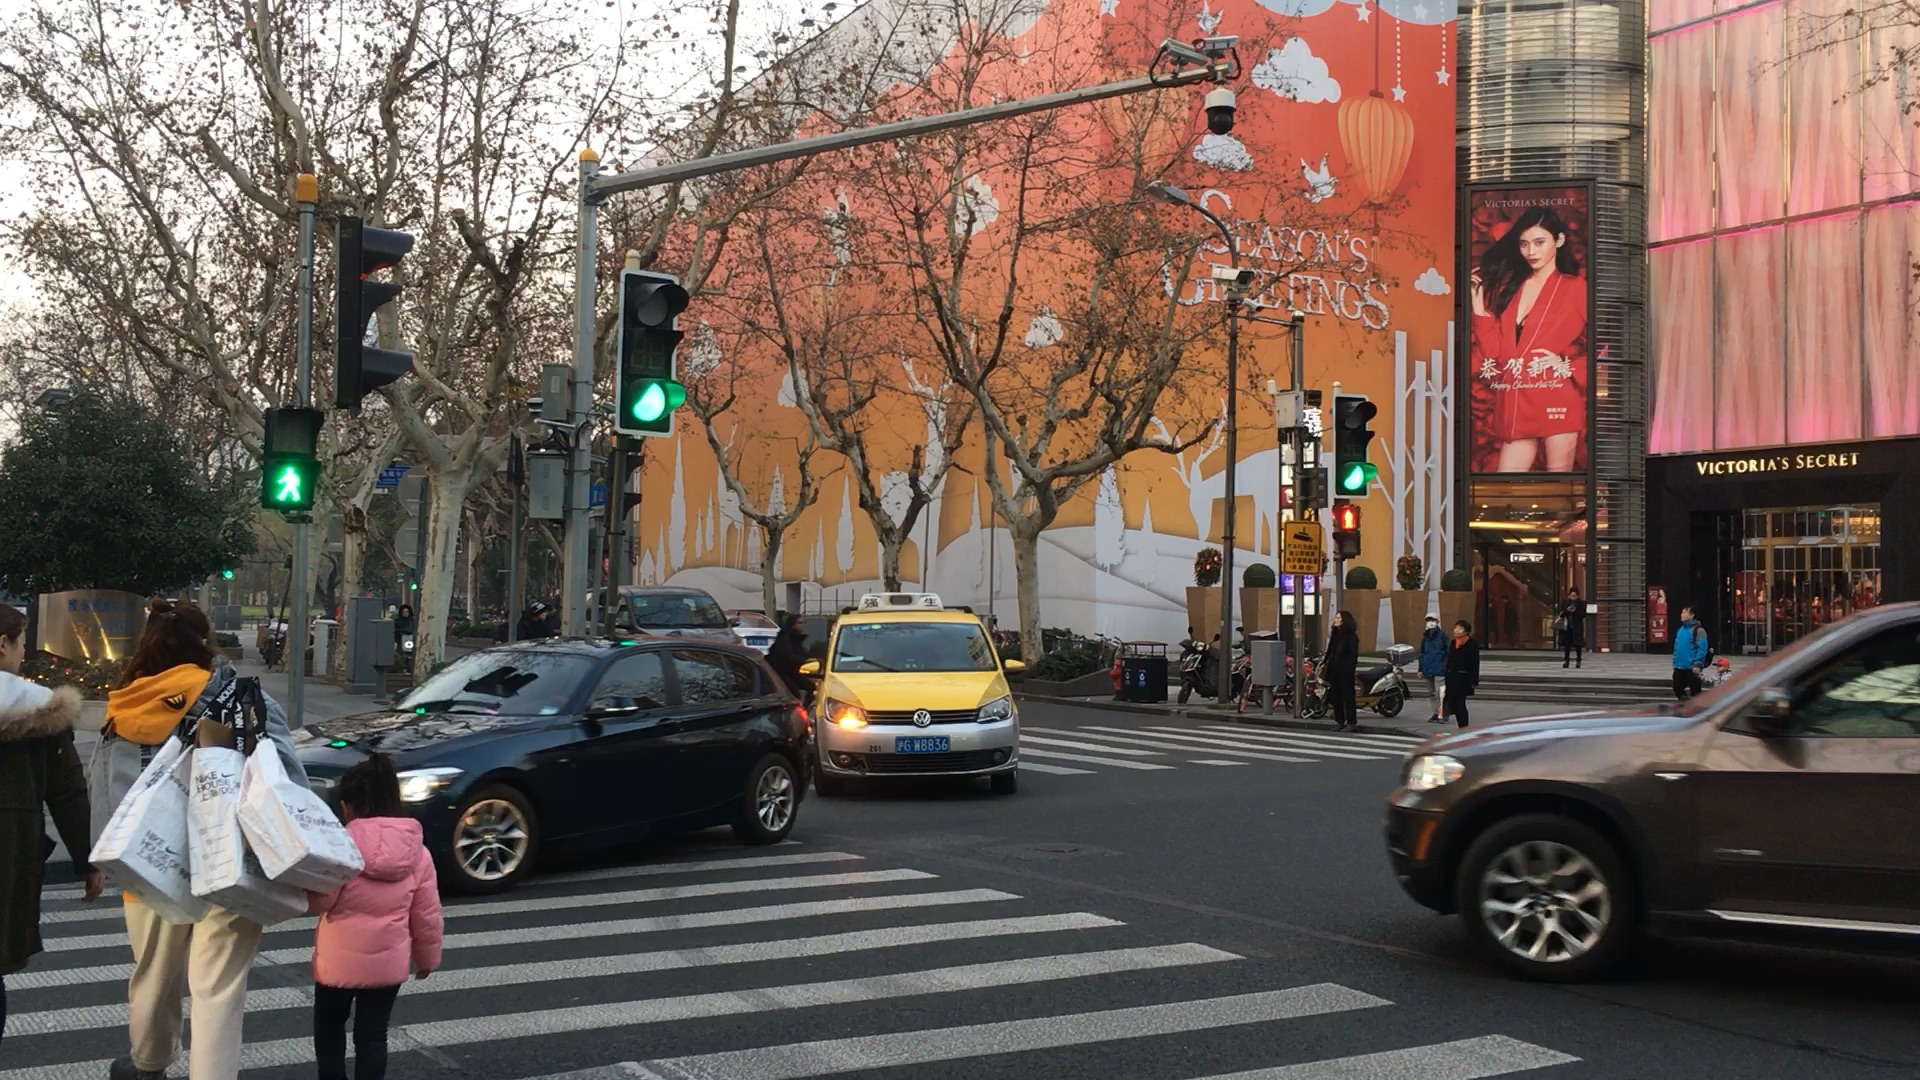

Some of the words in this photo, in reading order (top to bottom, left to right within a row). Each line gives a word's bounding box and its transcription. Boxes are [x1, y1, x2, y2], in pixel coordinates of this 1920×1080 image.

[1484, 200, 1537, 208] VICTORIA'S
[1539, 198, 1575, 206] SECRET
[1697, 457, 1789, 475] VICTORIA'S
[1796, 452, 1859, 469] SECRET
